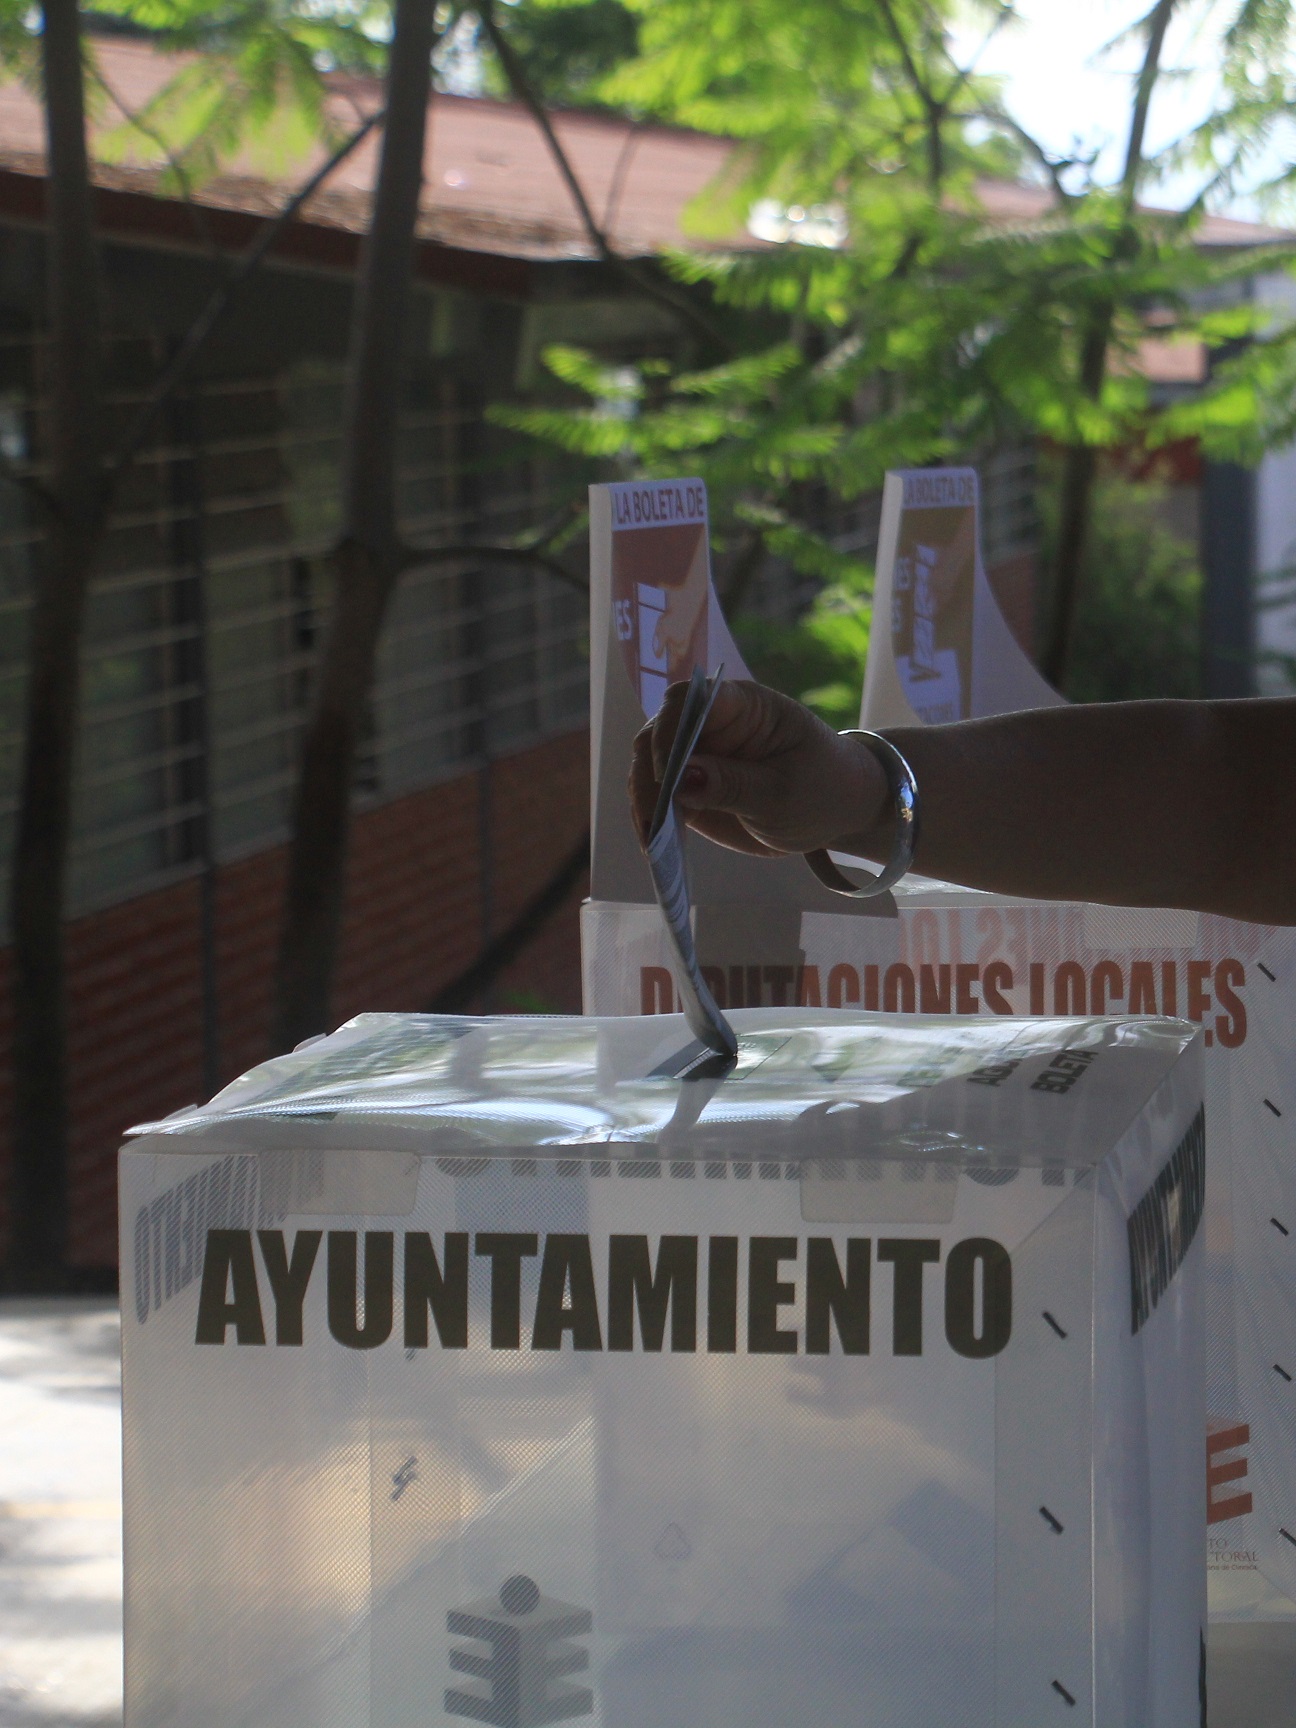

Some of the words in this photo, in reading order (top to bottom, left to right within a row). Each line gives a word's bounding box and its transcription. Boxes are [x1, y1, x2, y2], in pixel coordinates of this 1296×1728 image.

[615, 492, 631, 525] LA
[632, 488, 685, 523] BOLETA
[685, 487, 704, 518] DE
[640, 962, 1014, 1016] DUTACIONES
[1030, 1049, 1099, 1094] BOLETA
[195, 1229, 1013, 1359] AYUNTAMIENTO
